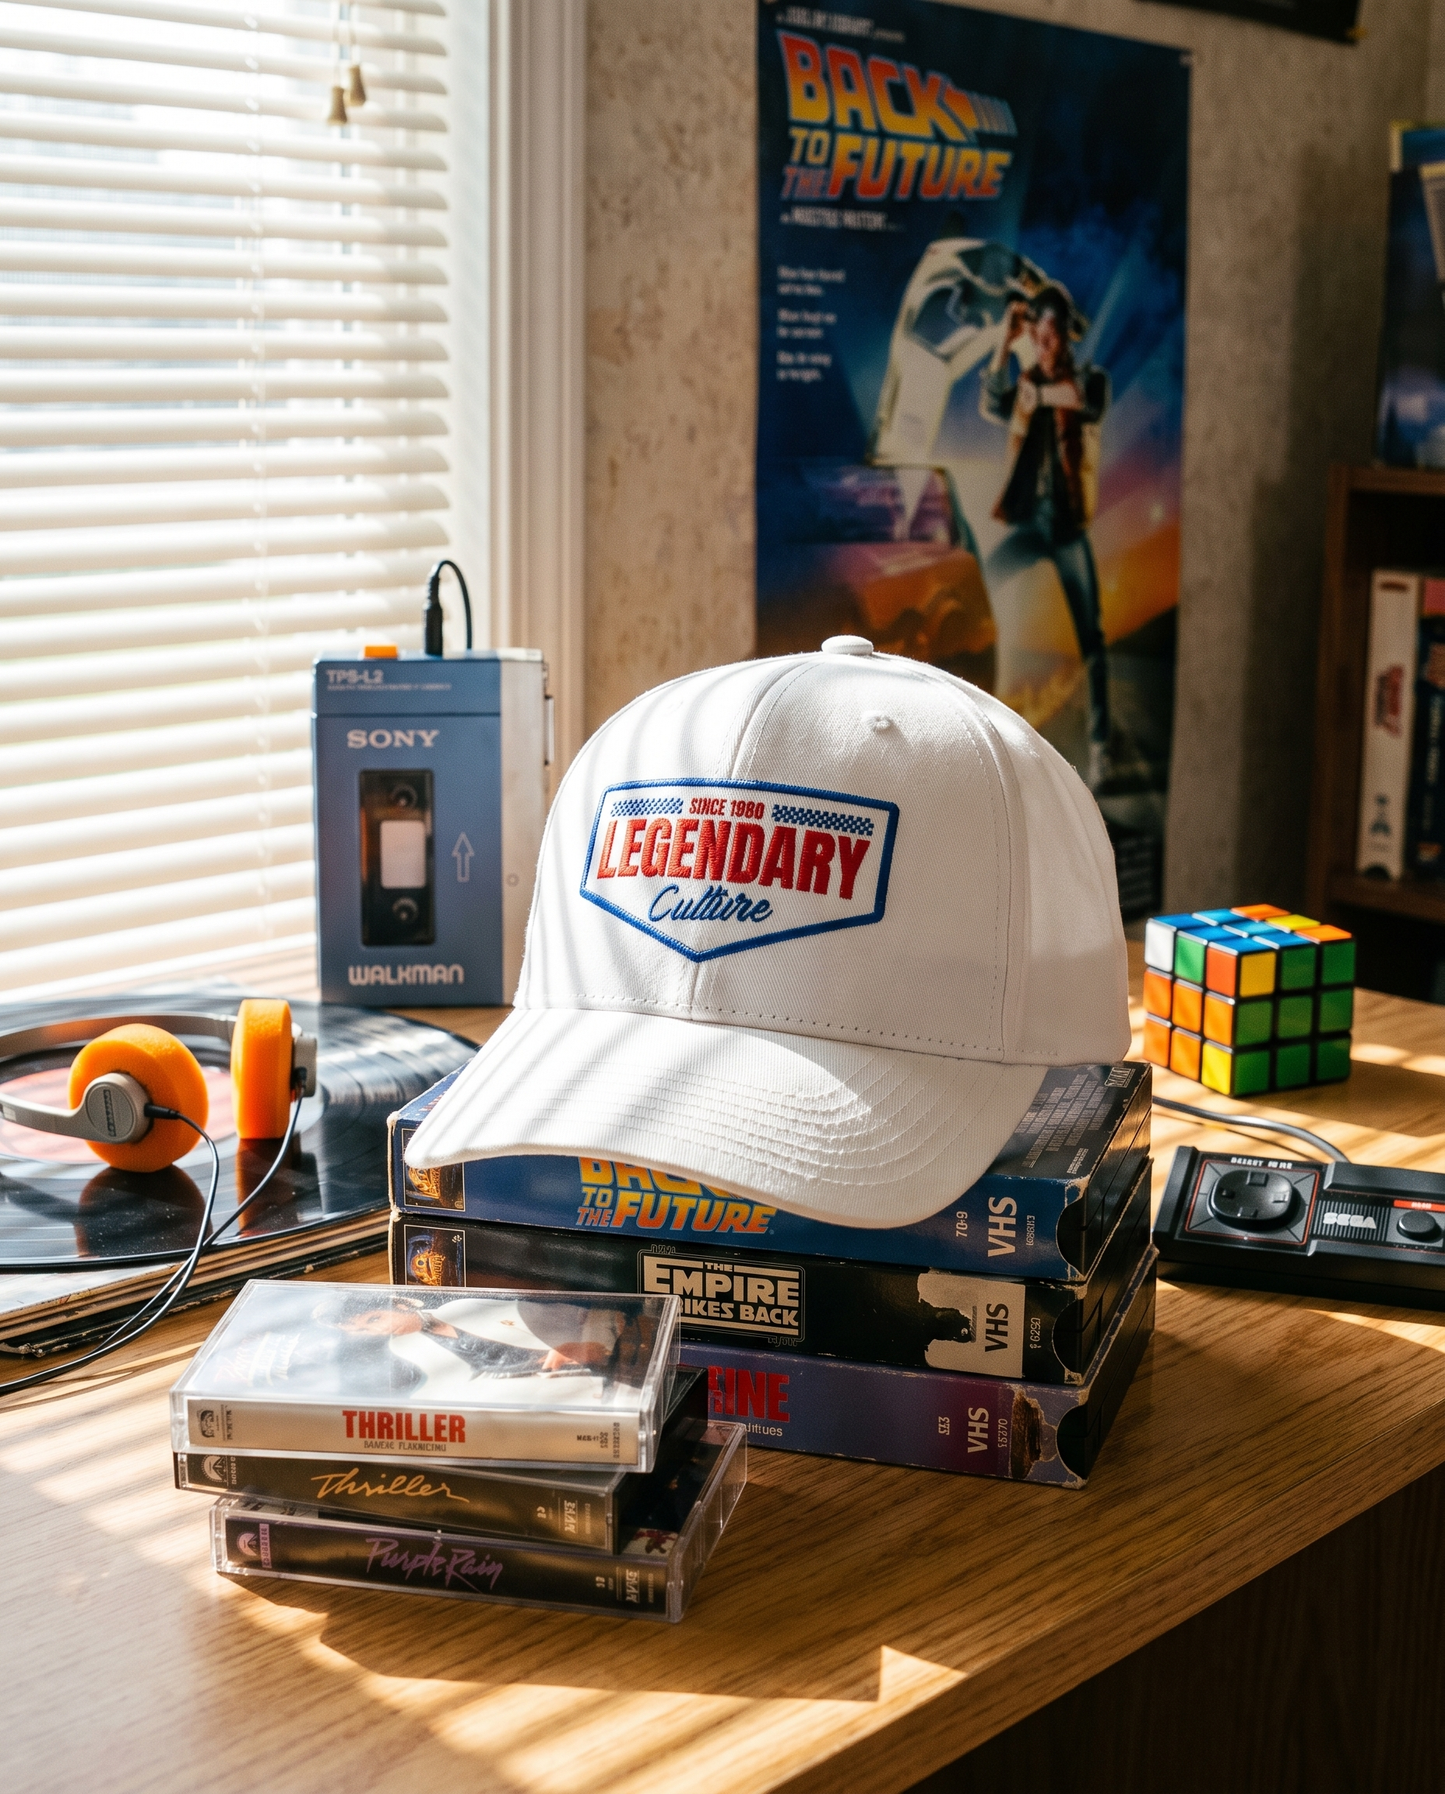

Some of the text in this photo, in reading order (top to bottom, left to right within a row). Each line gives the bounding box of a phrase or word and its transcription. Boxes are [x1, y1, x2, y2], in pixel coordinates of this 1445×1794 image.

[776, 29, 980, 146] BACK
[788, 127, 830, 166] TO
[826, 132, 1012, 200] FUTURE
[326, 669, 384, 685] TPS-L2
[346, 729, 440, 749] SONY
[689, 798, 765, 820] SINCE 1980
[597, 818, 871, 900] LEGENDARY
[648, 884, 773, 923] Culture
[348, 963, 465, 986] WALKMAN
[576, 1189, 778, 1235] THE FUTURE
[581, 1186, 613, 1208] TO
[987, 1196, 1018, 1258] VHS
[1322, 1211, 1377, 1229] SEGA
[643, 1255, 800, 1308] EMPIRE
[705, 1262, 733, 1272] THE
[679, 1297, 799, 1327] IKES BACK
[984, 1303, 1009, 1353] VHS
[342, 1410, 466, 1443] THRILLER
[967, 1407, 990, 1454] VHS
[311, 1467, 470, 1503] Thriller
[366, 1537, 503, 1594] Purple Rain
